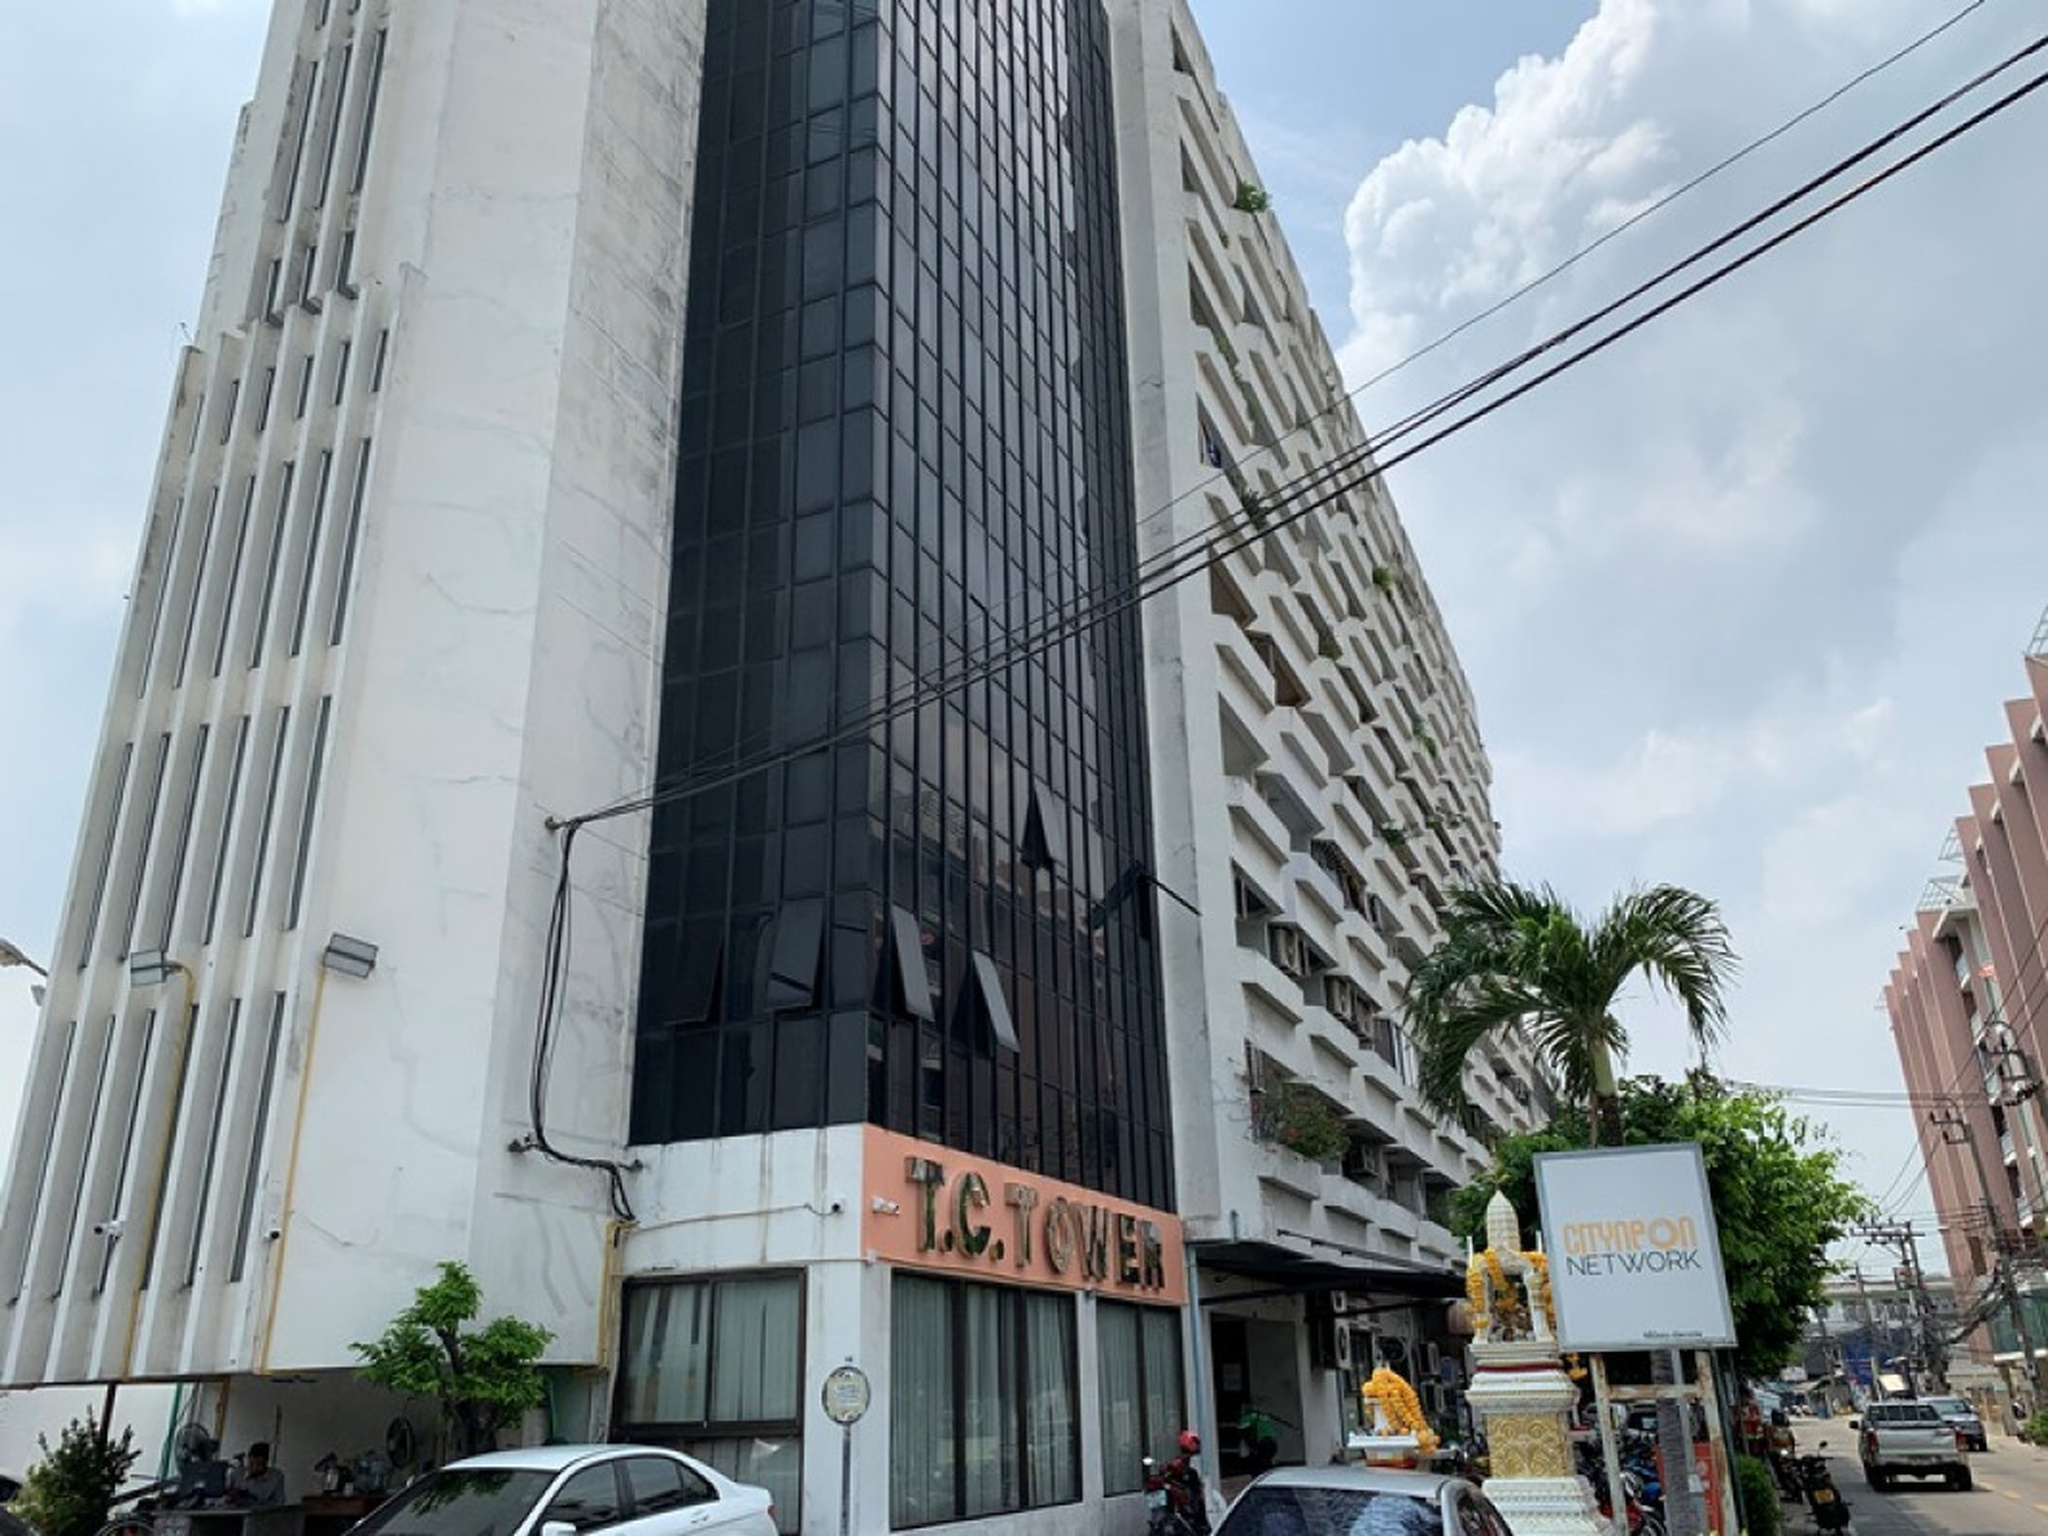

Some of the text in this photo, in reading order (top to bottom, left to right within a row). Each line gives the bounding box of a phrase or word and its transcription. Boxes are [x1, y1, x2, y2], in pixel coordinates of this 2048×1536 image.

[904, 1156, 1165, 1290] T.C. TOWER
[1565, 1248, 1702, 1276] NETWORK
